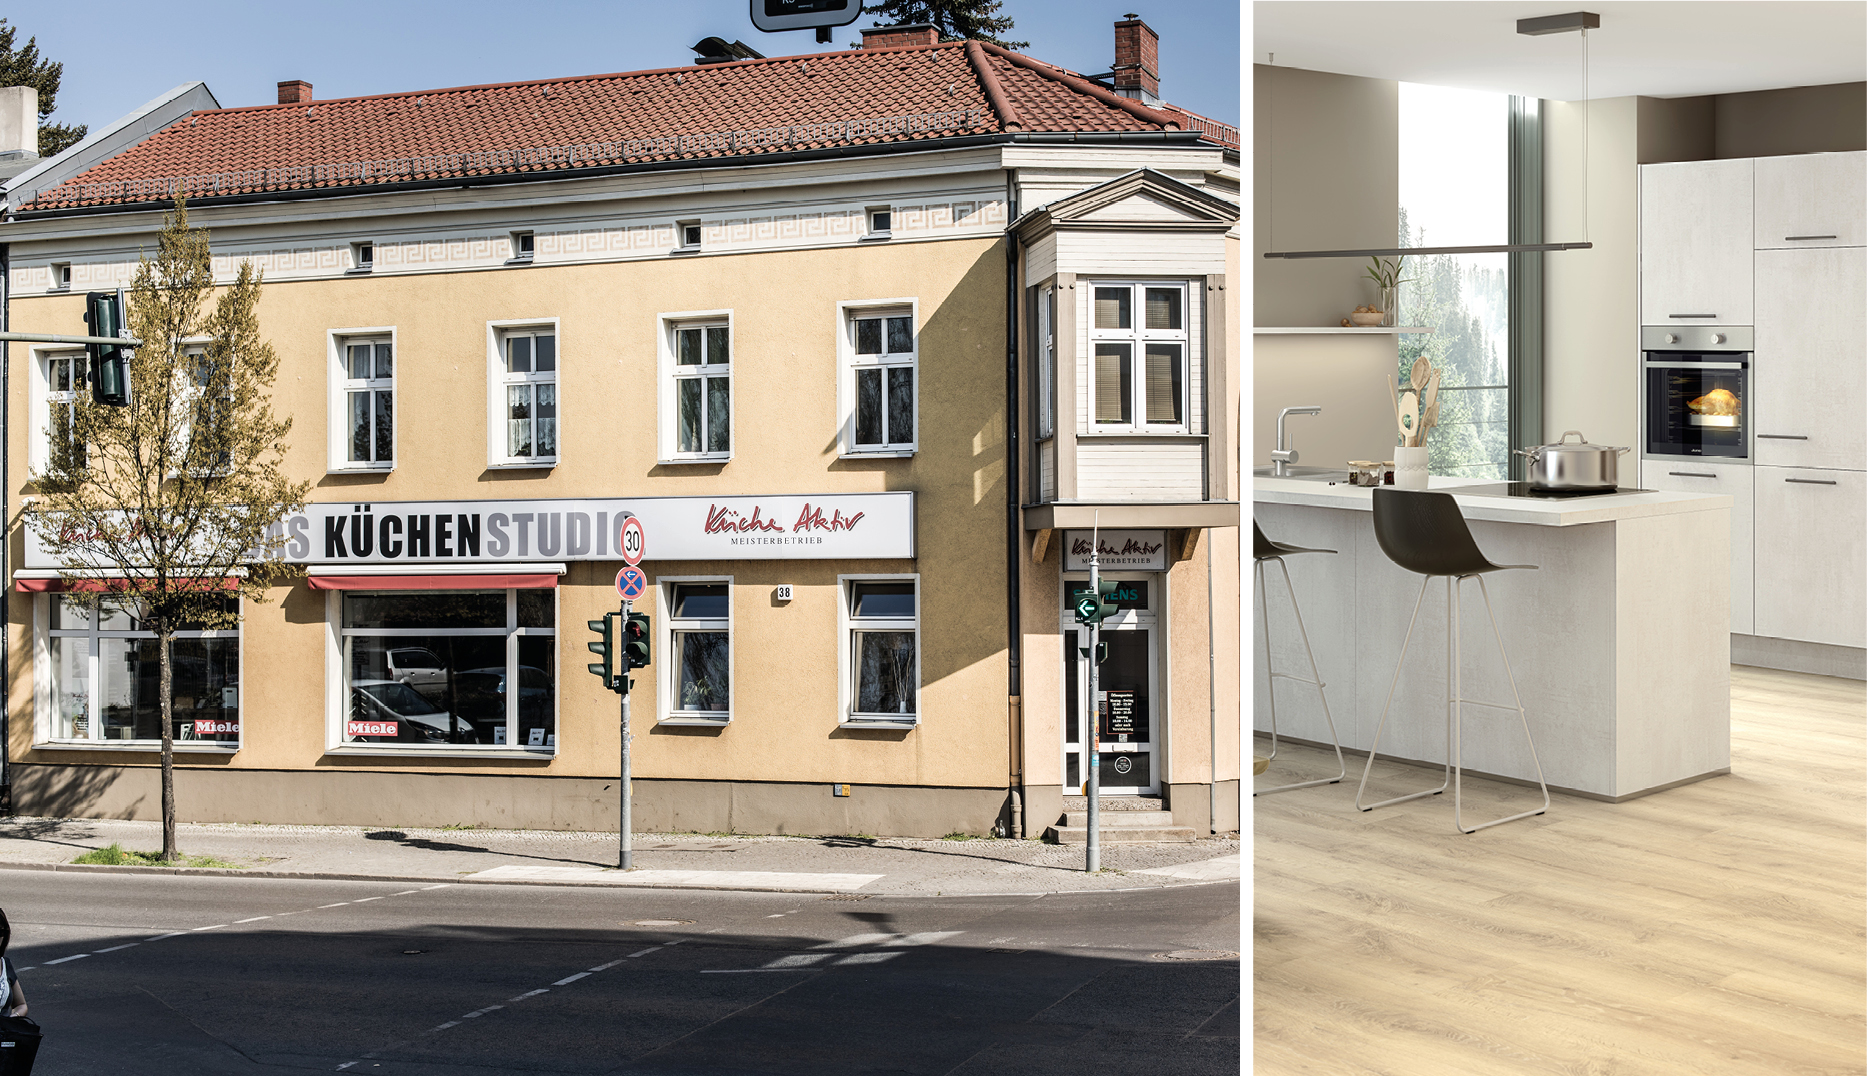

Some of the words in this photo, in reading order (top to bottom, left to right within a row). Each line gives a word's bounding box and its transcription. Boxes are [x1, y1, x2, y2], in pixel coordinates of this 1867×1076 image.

[704, 503, 785, 534] Küche
[793, 503, 865, 533] Aktiv
[625, 530, 640, 552] 30
[730, 537, 823, 545] MEISTERBETRIEB
[1071, 538, 1120, 555] Kühe
[1121, 538, 1162, 555] Aktiv
[778, 587, 791, 598] 38
[196, 721, 239, 732] Miele
[348, 722, 396, 734] Miele
